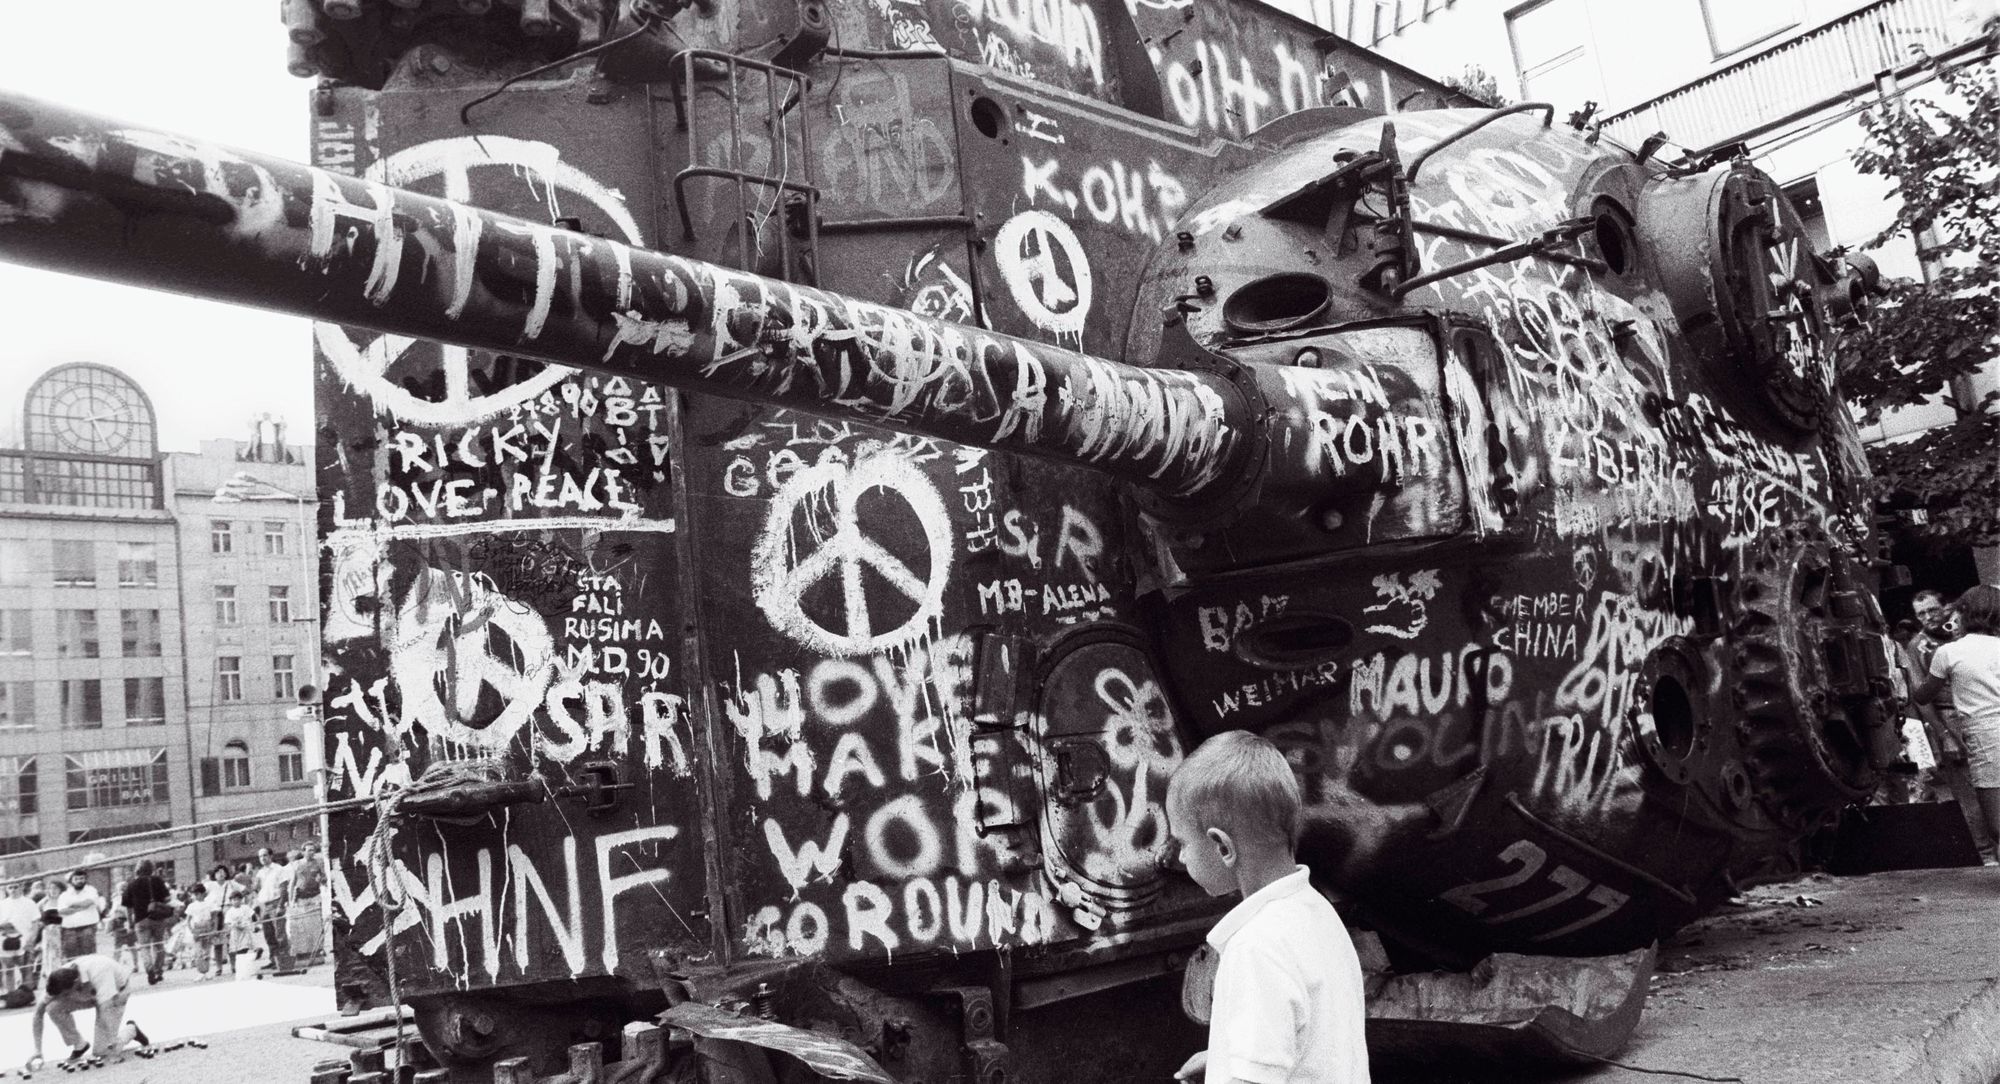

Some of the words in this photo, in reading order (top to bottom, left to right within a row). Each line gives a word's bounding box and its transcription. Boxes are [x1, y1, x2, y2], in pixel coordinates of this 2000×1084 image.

[386, 417, 561, 475] RICKY
[1304, 411, 1436, 487] ROHR
[1491, 620, 1577, 662] CHINA
[636, 649, 670, 679] 90
[88, 769, 140, 785] GRILL
[121, 790, 151, 801] BAR
[1439, 839, 1631, 940] 277
